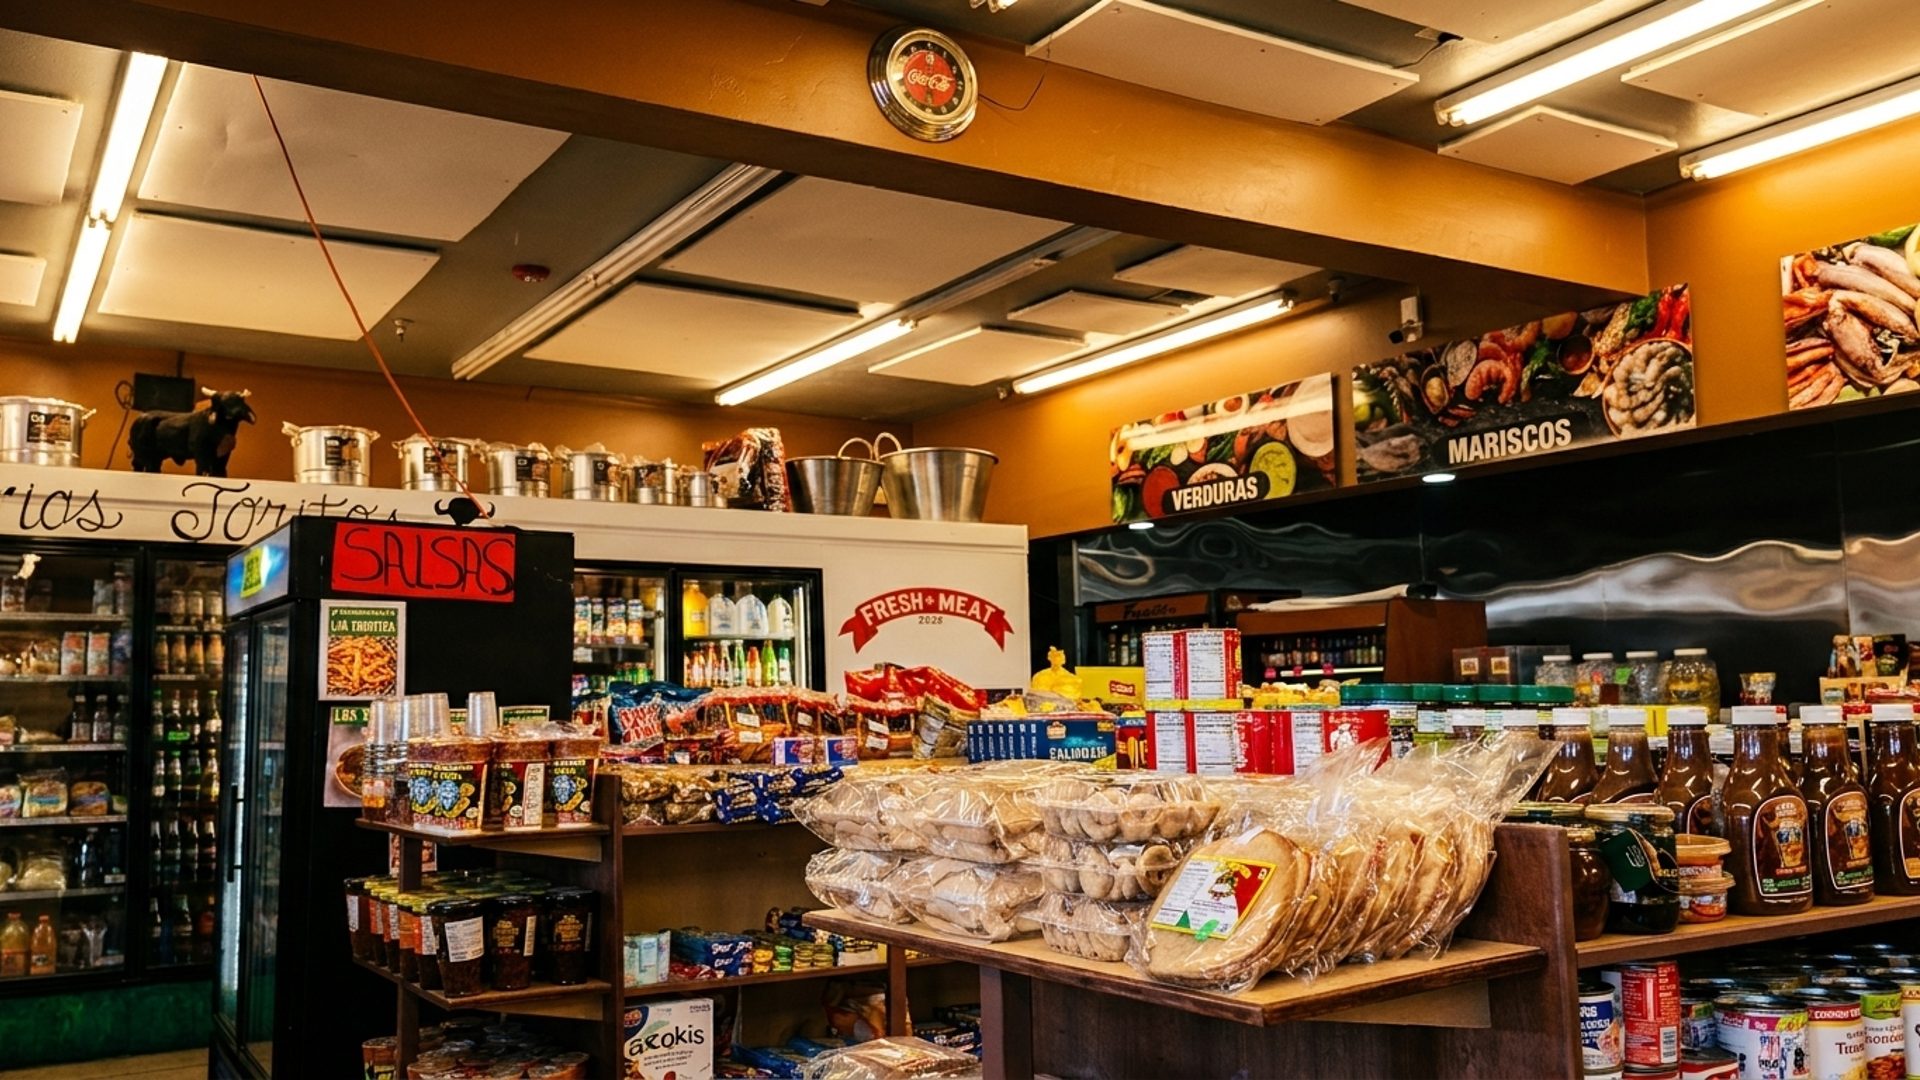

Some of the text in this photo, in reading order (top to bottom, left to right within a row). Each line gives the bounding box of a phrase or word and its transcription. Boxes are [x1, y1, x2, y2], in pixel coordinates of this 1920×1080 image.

[1448, 418, 1572, 464] MARISCOS
[1171, 476, 1258, 511] VERDURAS
[340, 527, 515, 595] SALSAS
[859, 592, 996, 626] FRESH MEAT
